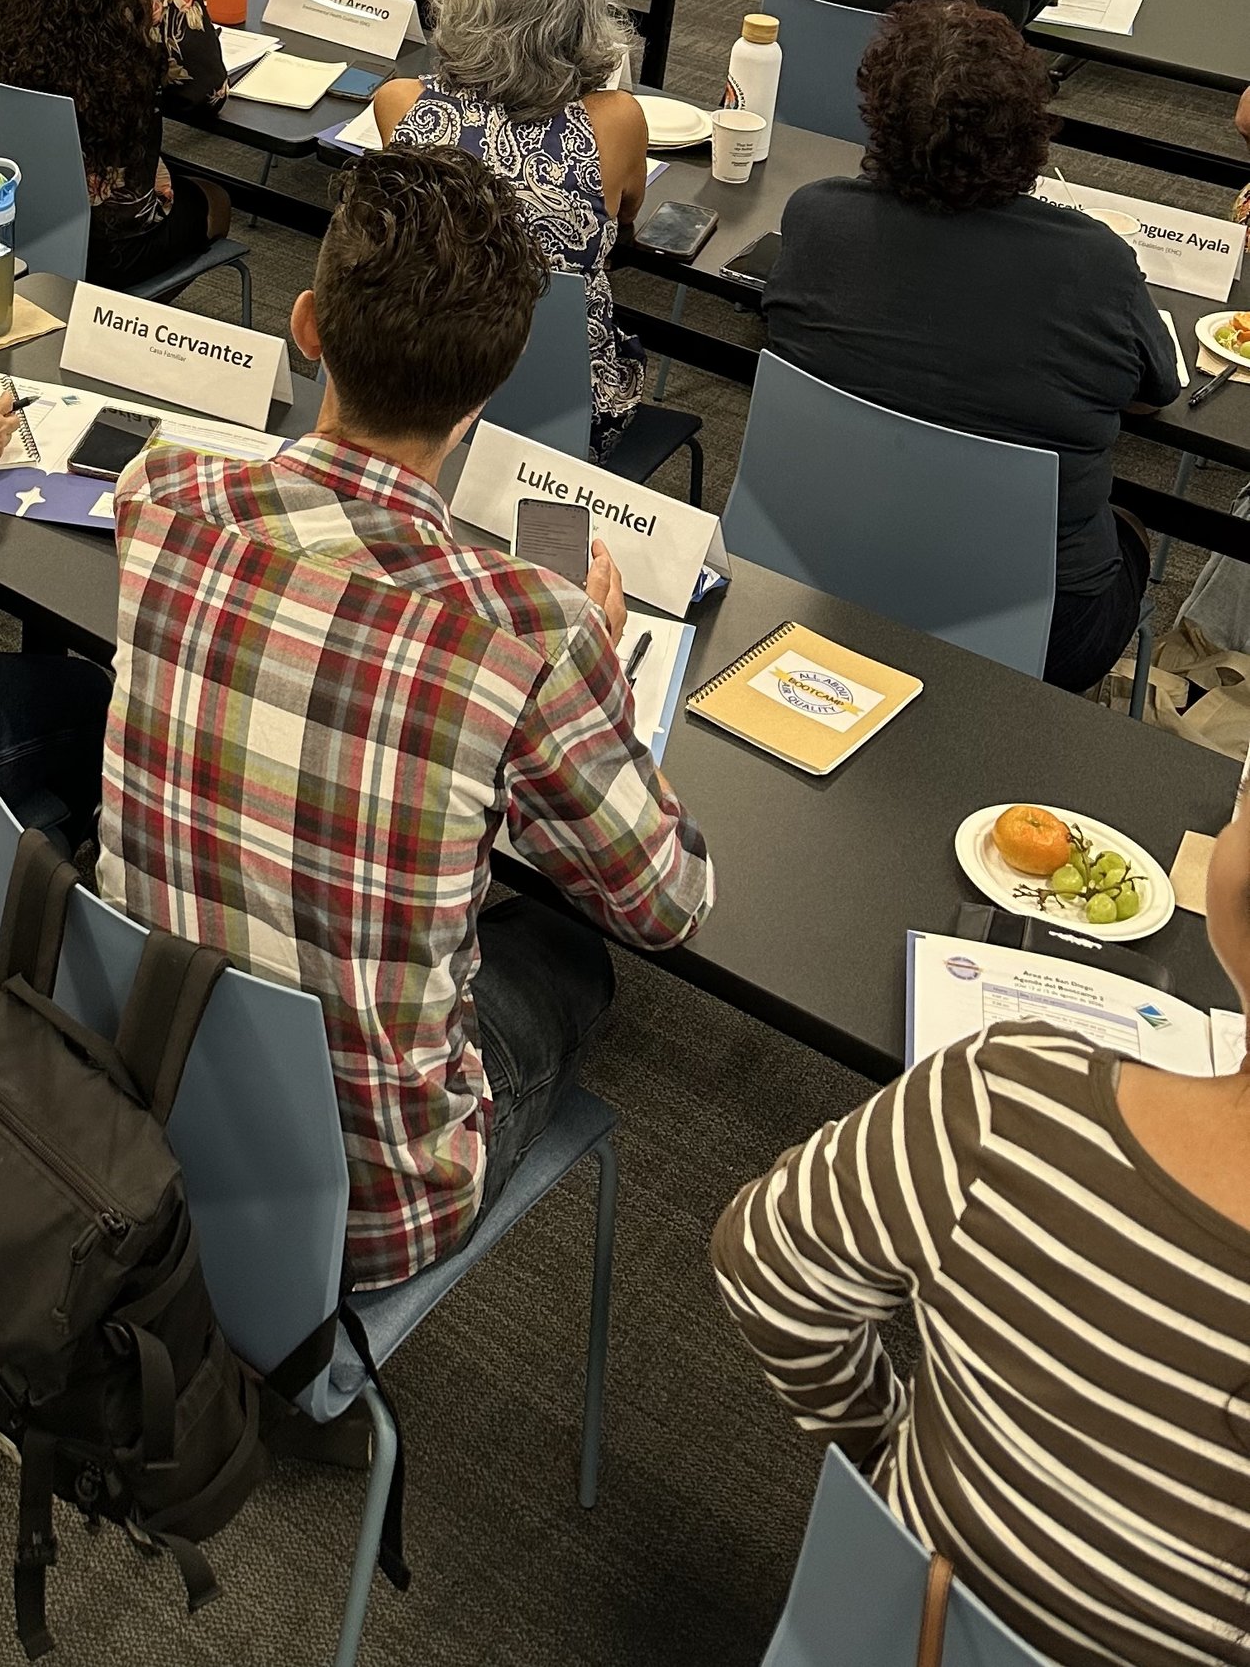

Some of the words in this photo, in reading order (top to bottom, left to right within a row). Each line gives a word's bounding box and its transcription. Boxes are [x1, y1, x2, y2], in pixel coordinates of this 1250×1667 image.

[1137, 220, 1184, 243] nguez
[1186, 233, 1231, 254] Ayala
[1137, 240, 1165, 252] Coalition
[93, 306, 149, 338] Maria
[154, 325, 254, 369] Cervantez
[149, 346, 163, 356] Casa
[164, 350, 187, 363] Familiar
[516, 462, 569, 500] Luke
[575, 486, 657, 537] Henkel
[788, 677, 845, 706] BOOTCAMP
[799, 673, 821, 682] ALL
[824, 678, 850, 701] ABOUT
[788, 695, 837, 713] QUALITY
